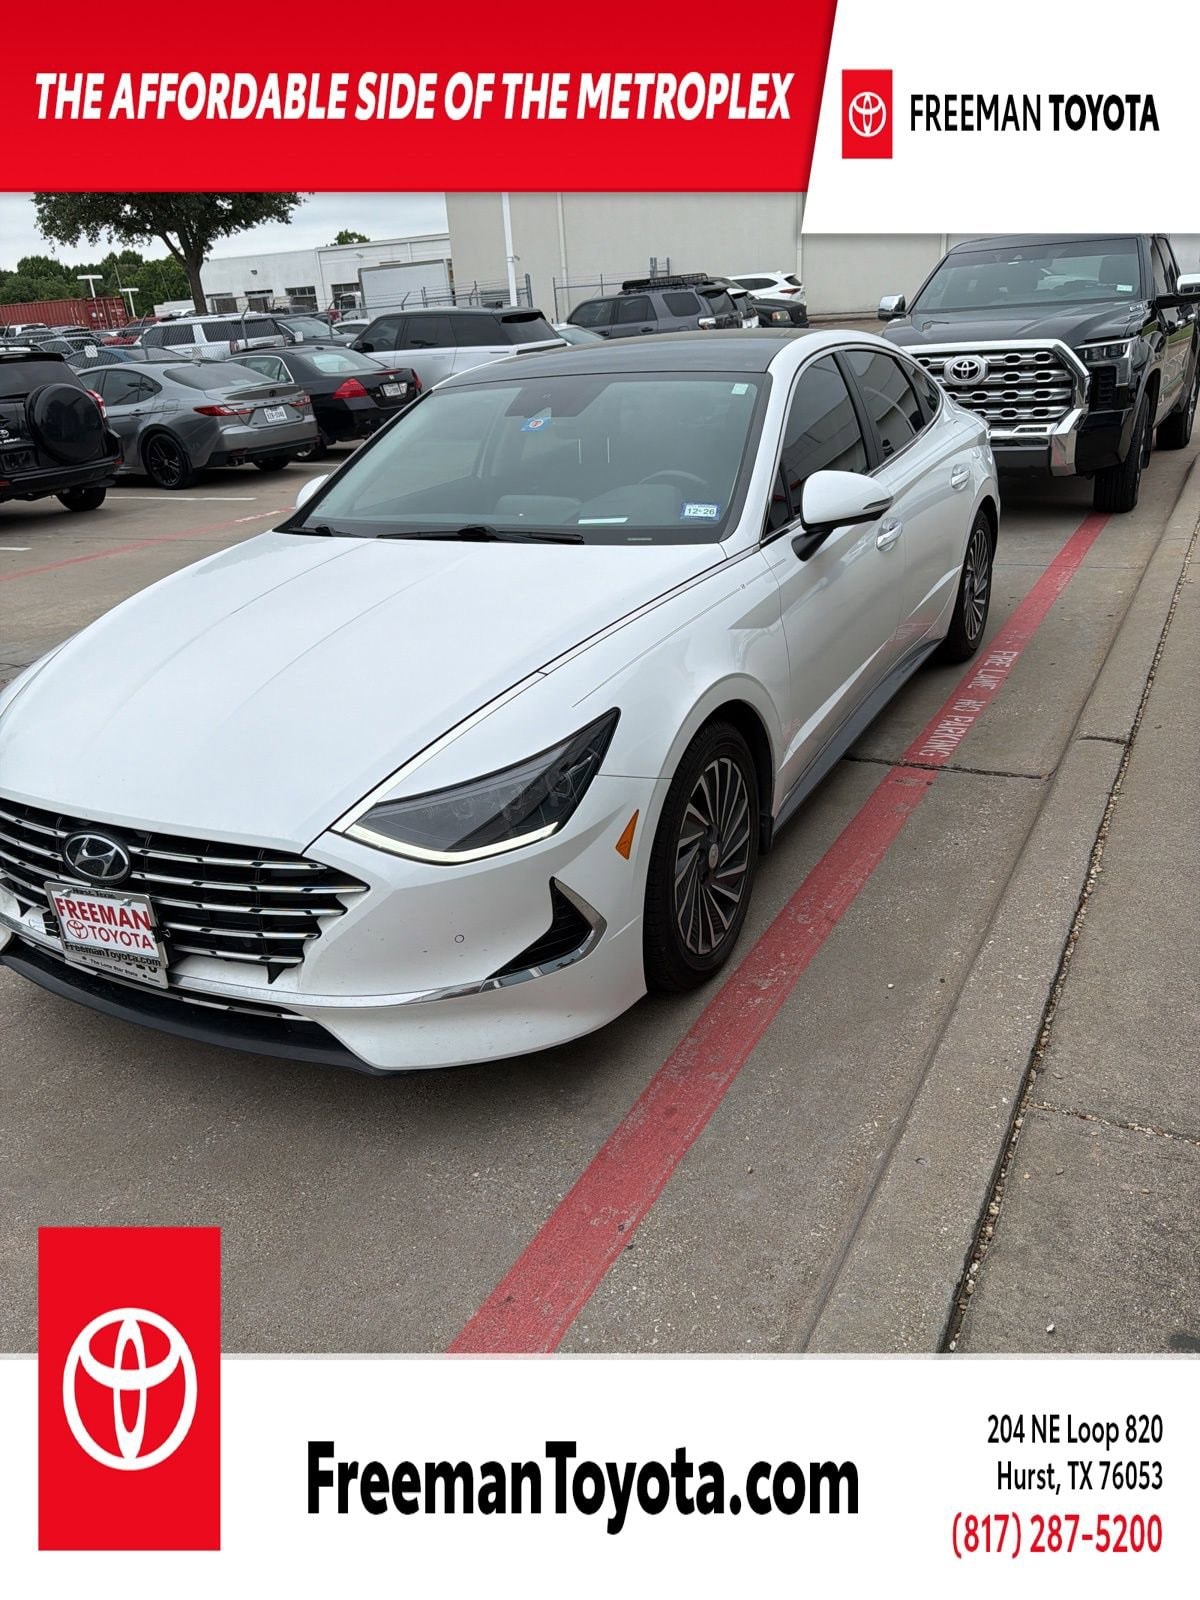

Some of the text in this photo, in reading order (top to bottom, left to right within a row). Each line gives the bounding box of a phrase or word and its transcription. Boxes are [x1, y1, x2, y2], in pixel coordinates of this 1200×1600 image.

[918, 714, 976, 758] PARKING
[55, 898, 151, 931] FREEMAN
[88, 925, 154, 950] TOYOTA
[65, 941, 162, 967] FreemanToyota.com
